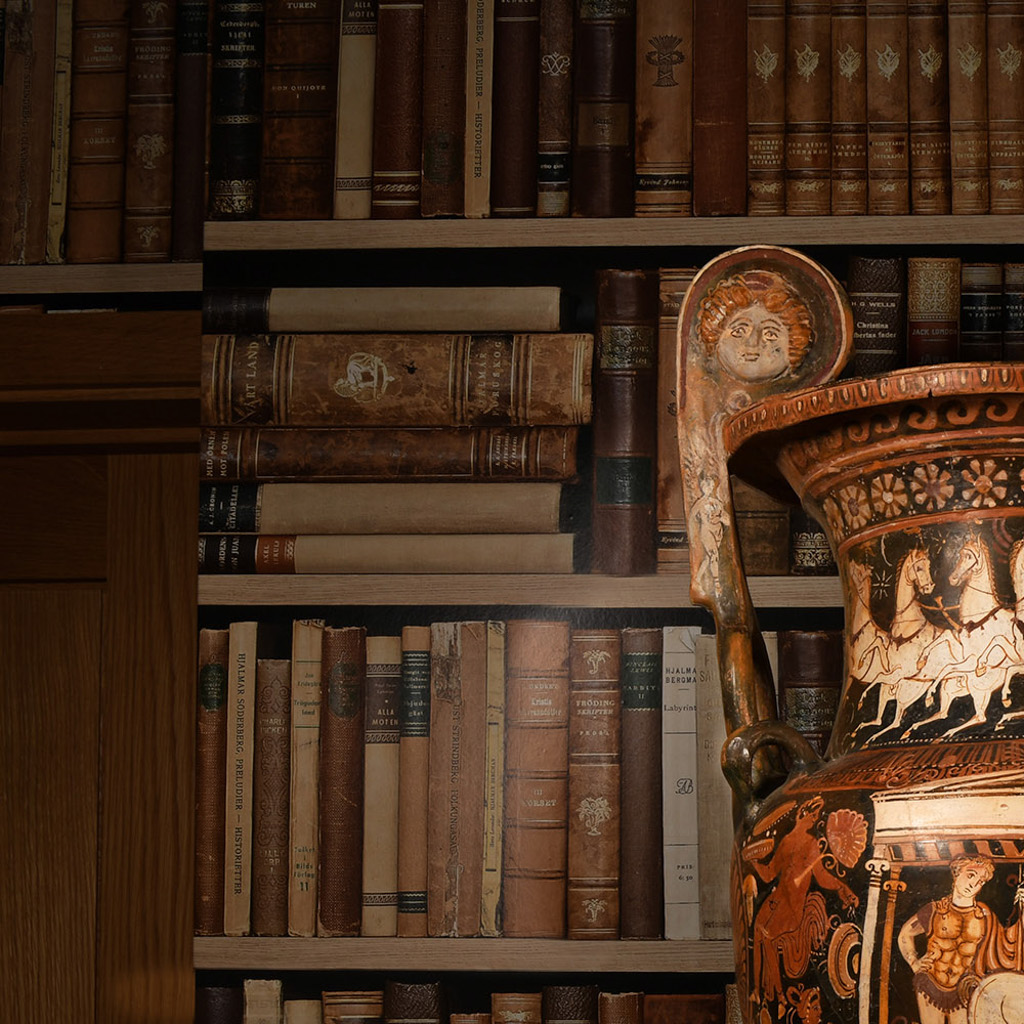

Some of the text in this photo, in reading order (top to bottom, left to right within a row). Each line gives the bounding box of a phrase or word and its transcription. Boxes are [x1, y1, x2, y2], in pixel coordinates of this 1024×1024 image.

[237, 653, 246, 694] HJALMAR
[235, 759, 243, 810] PRELUDIER
[233, 827, 243, 895] HISTORIETTER
